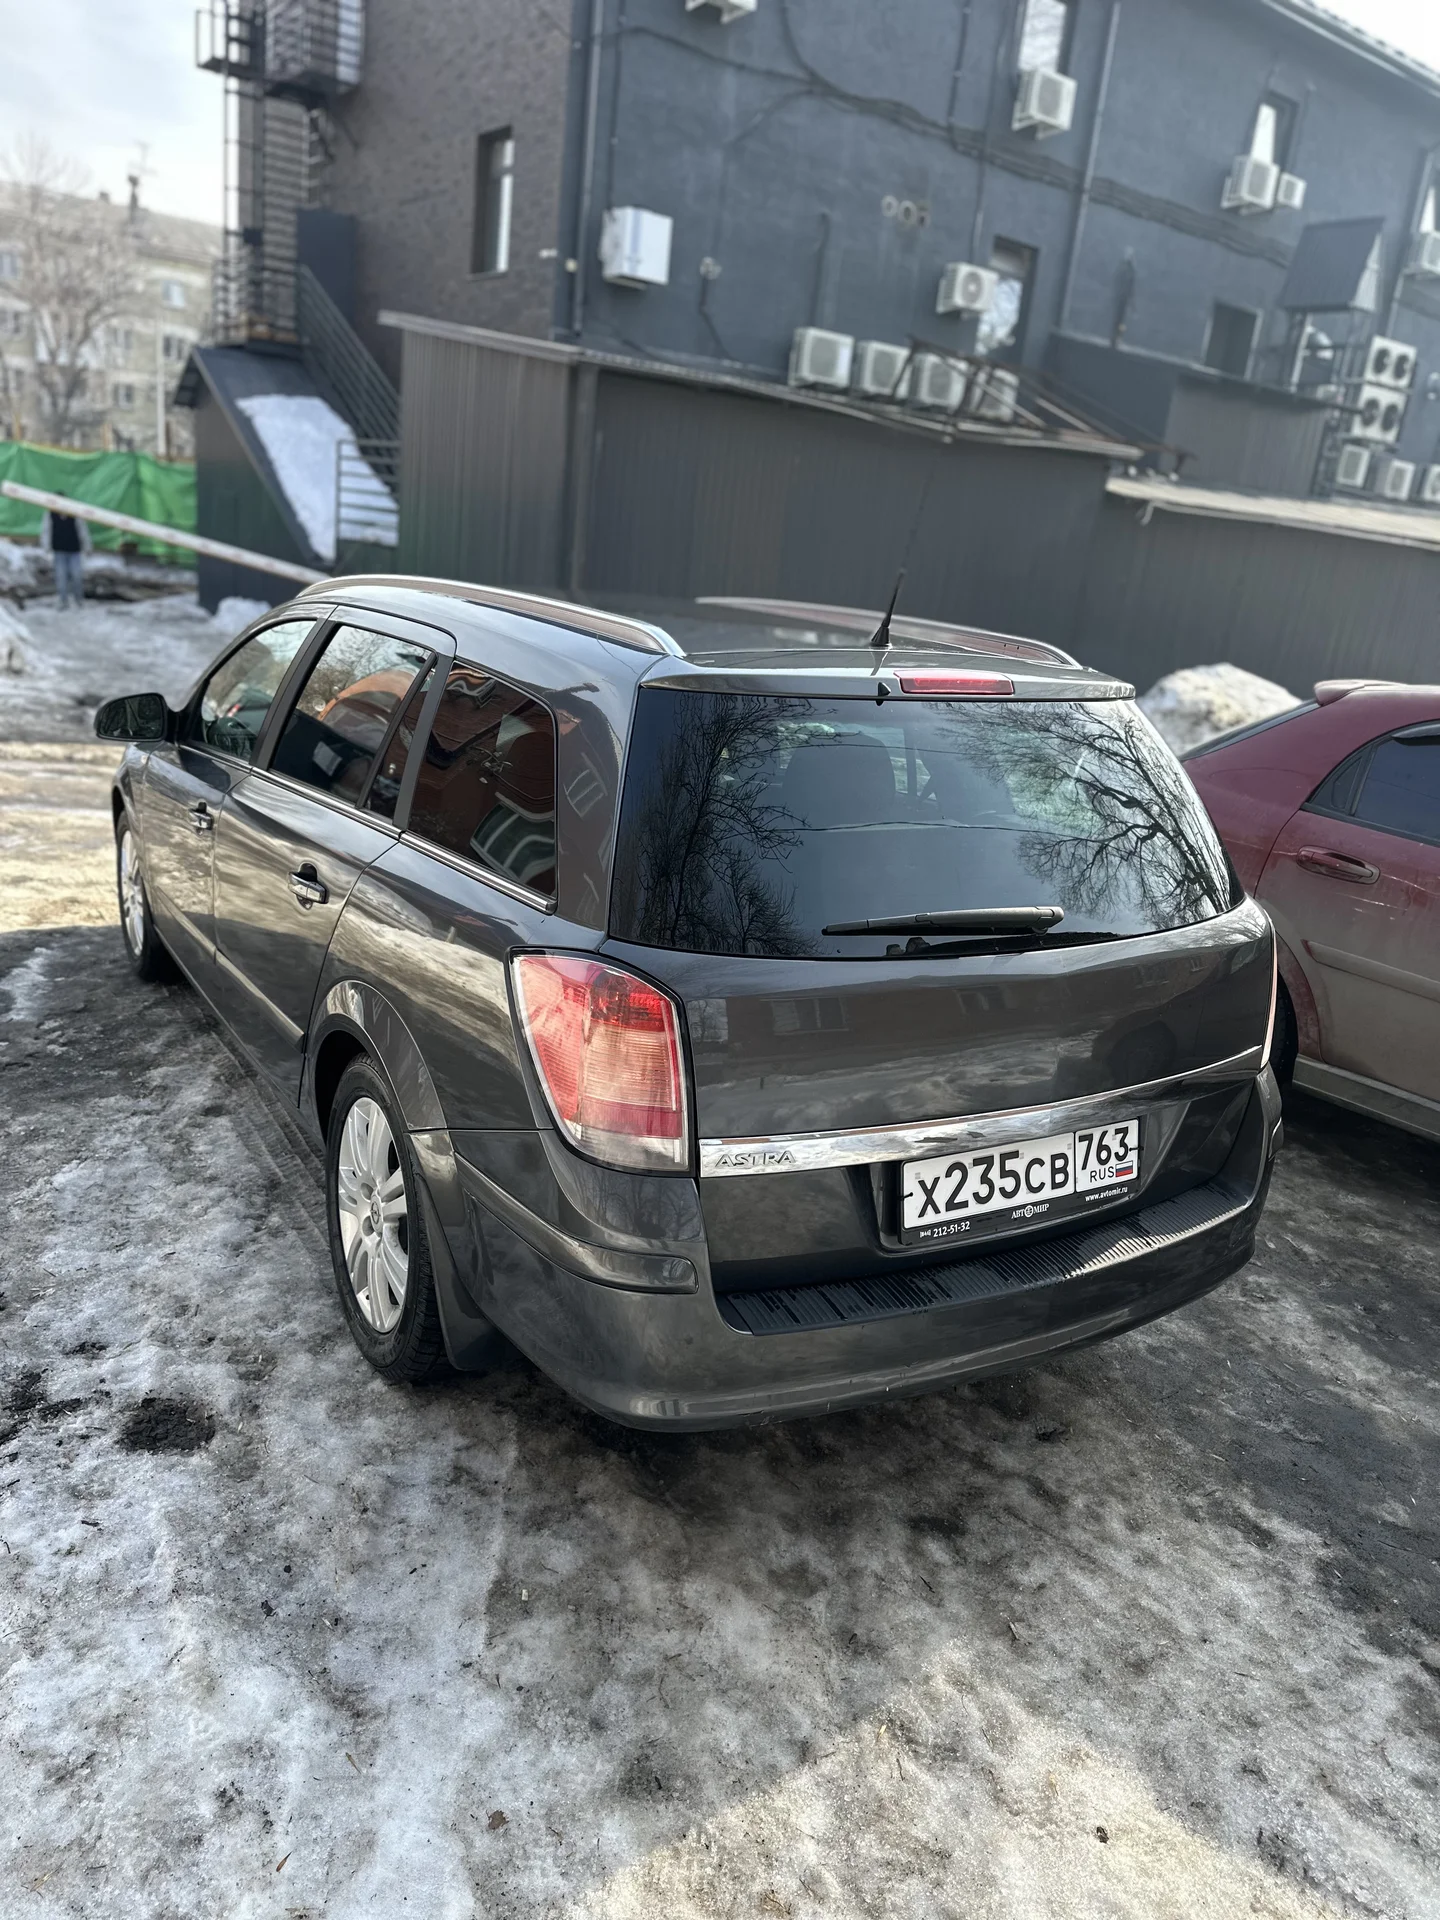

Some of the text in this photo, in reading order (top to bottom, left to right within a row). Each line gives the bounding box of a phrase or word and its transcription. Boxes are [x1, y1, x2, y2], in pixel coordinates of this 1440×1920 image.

[1078, 1126, 1130, 1171] 763
[715, 1150, 796, 1168] ASTRA
[1089, 1165, 1115, 1183] RUS
[1084, 1186, 1128, 1202] www.avtomir.ru
[933, 1221, 970, 1238] 212-51-32
